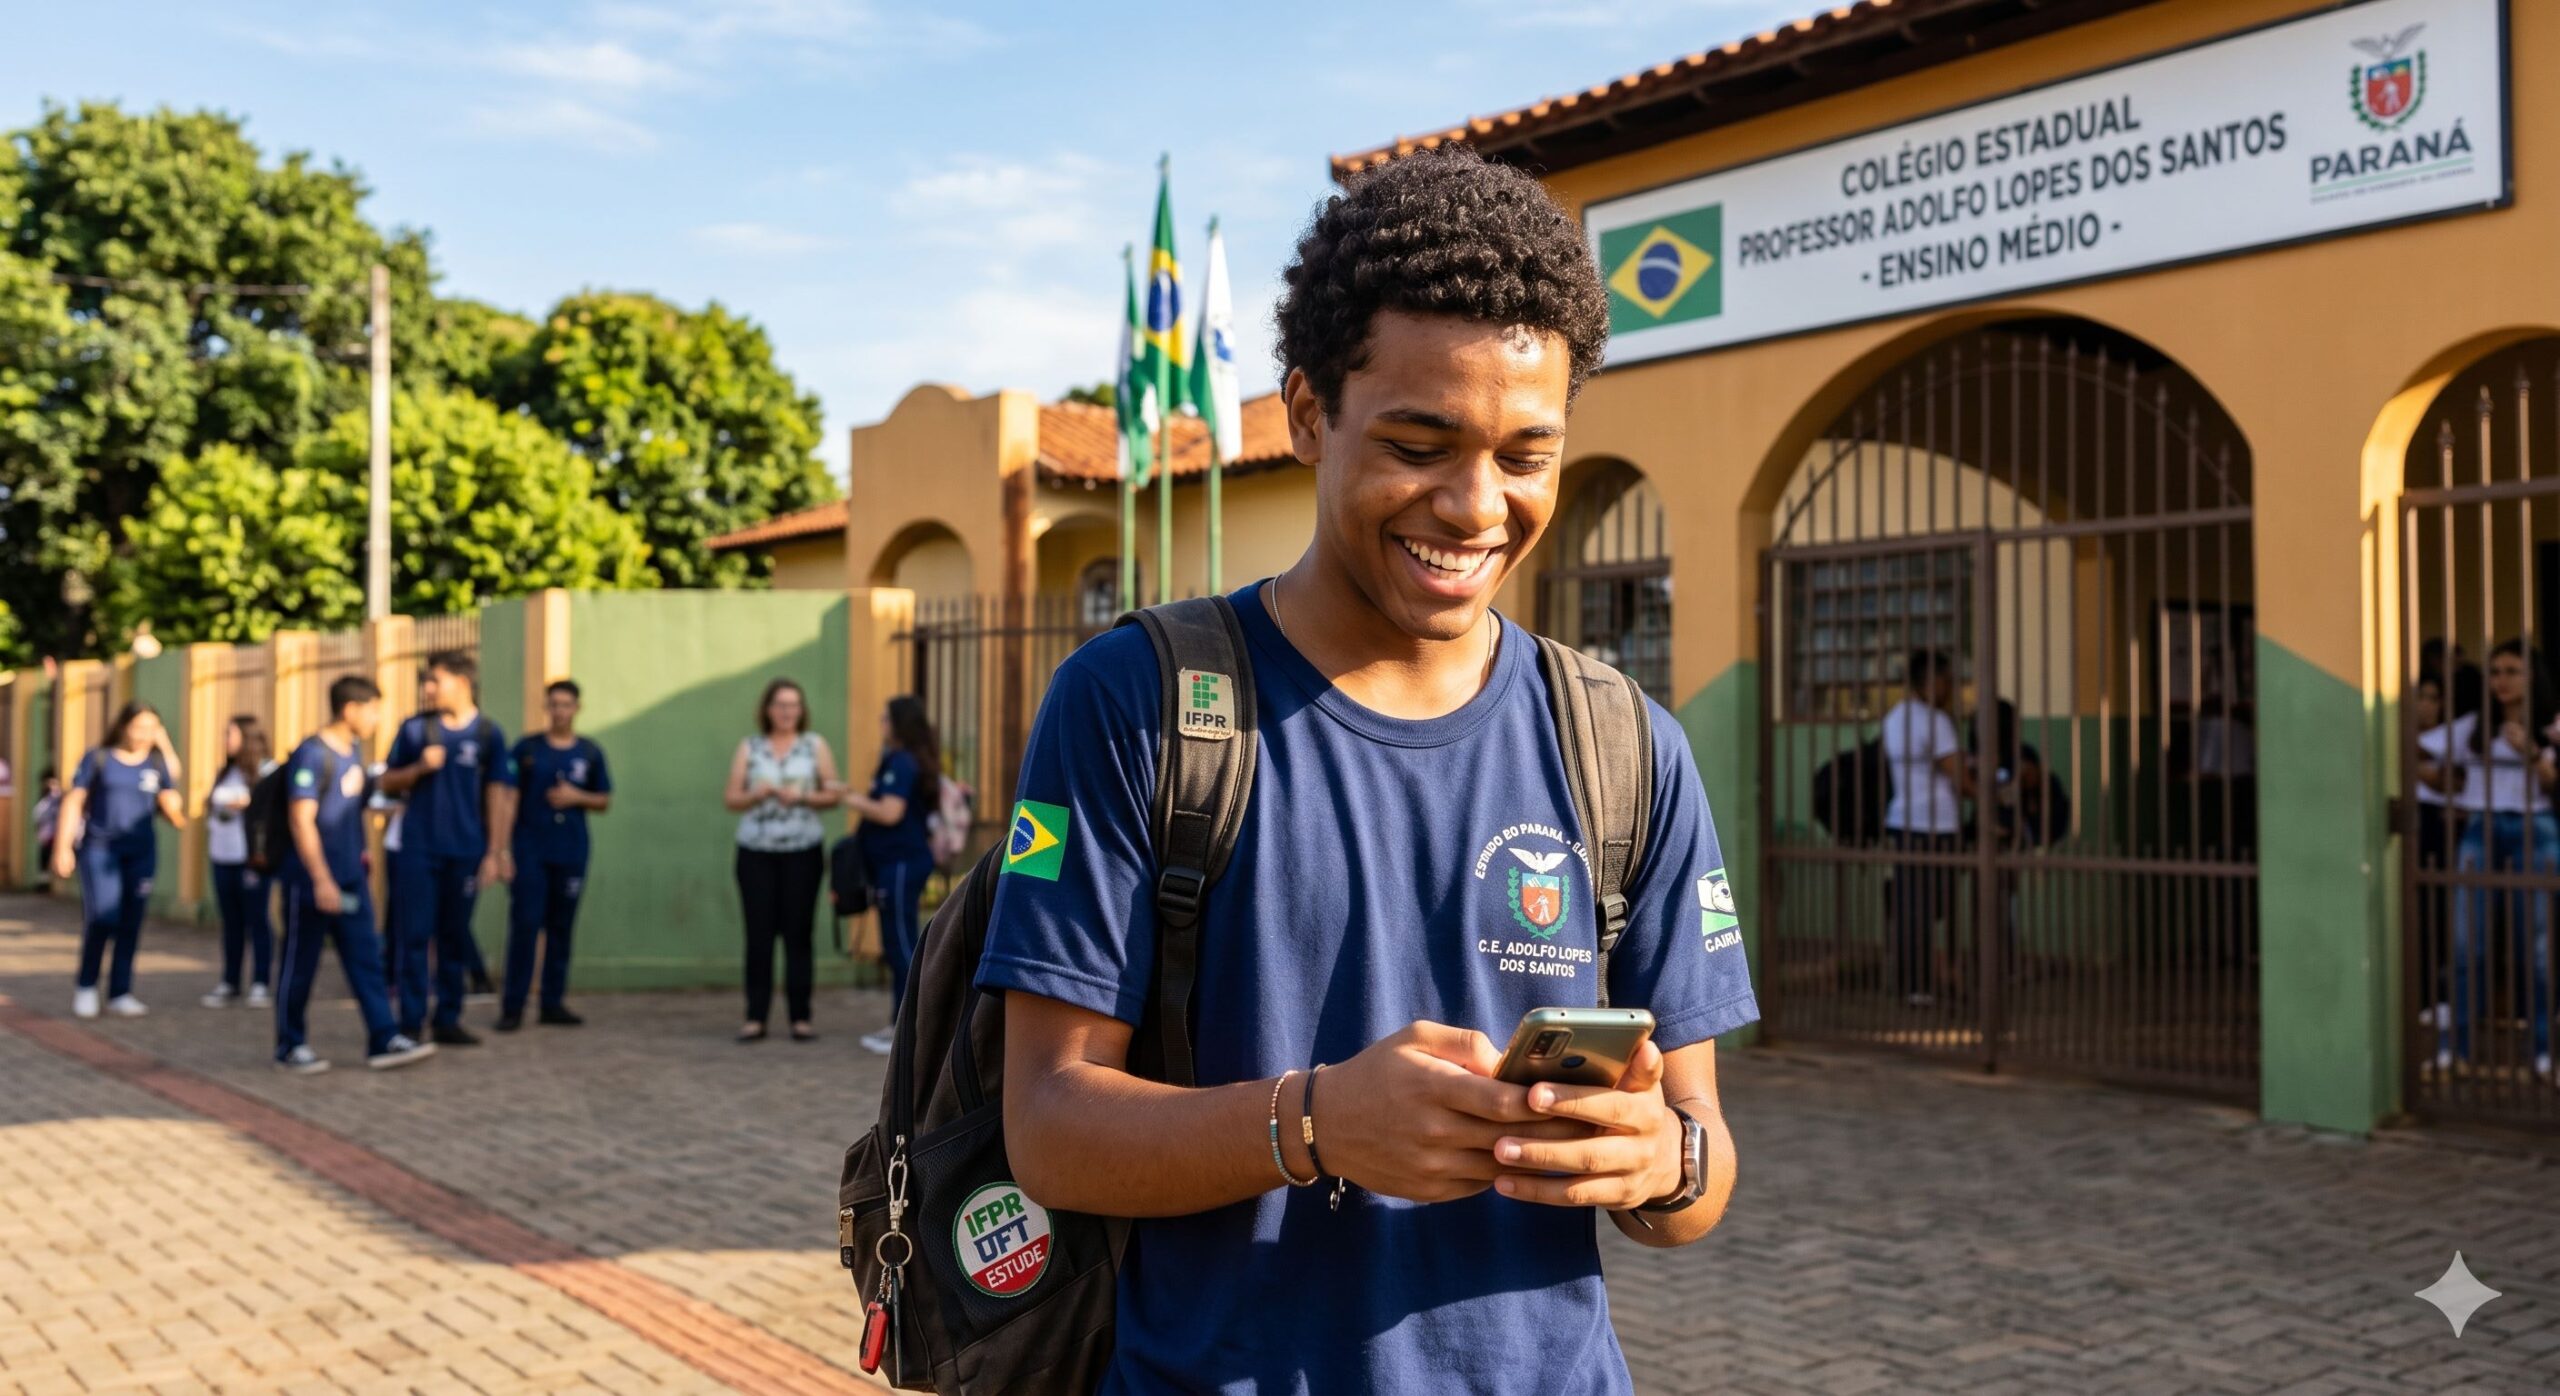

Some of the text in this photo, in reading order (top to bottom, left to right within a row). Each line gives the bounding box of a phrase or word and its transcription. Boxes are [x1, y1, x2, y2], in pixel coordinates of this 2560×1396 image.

[1841, 95, 2141, 198] COLÉGIO ESTADUAL
[2310, 116, 2472, 184] PARANÁ
[1738, 111, 2287, 268] PROFESSOR ADOLFO LOPES DOS SANTOS
[1879, 235, 1989, 289] ENSINO
[1999, 212, 2100, 267] MÉDIO
[1185, 711, 1226, 728] IFPR
[1478, 939, 1592, 963] C.E. ADOLFO LOPES
[1500, 958, 1575, 978] DOS SANTOS
[965, 1192, 1026, 1238] IFPR
[986, 1243, 1046, 1289] ESTUDE
